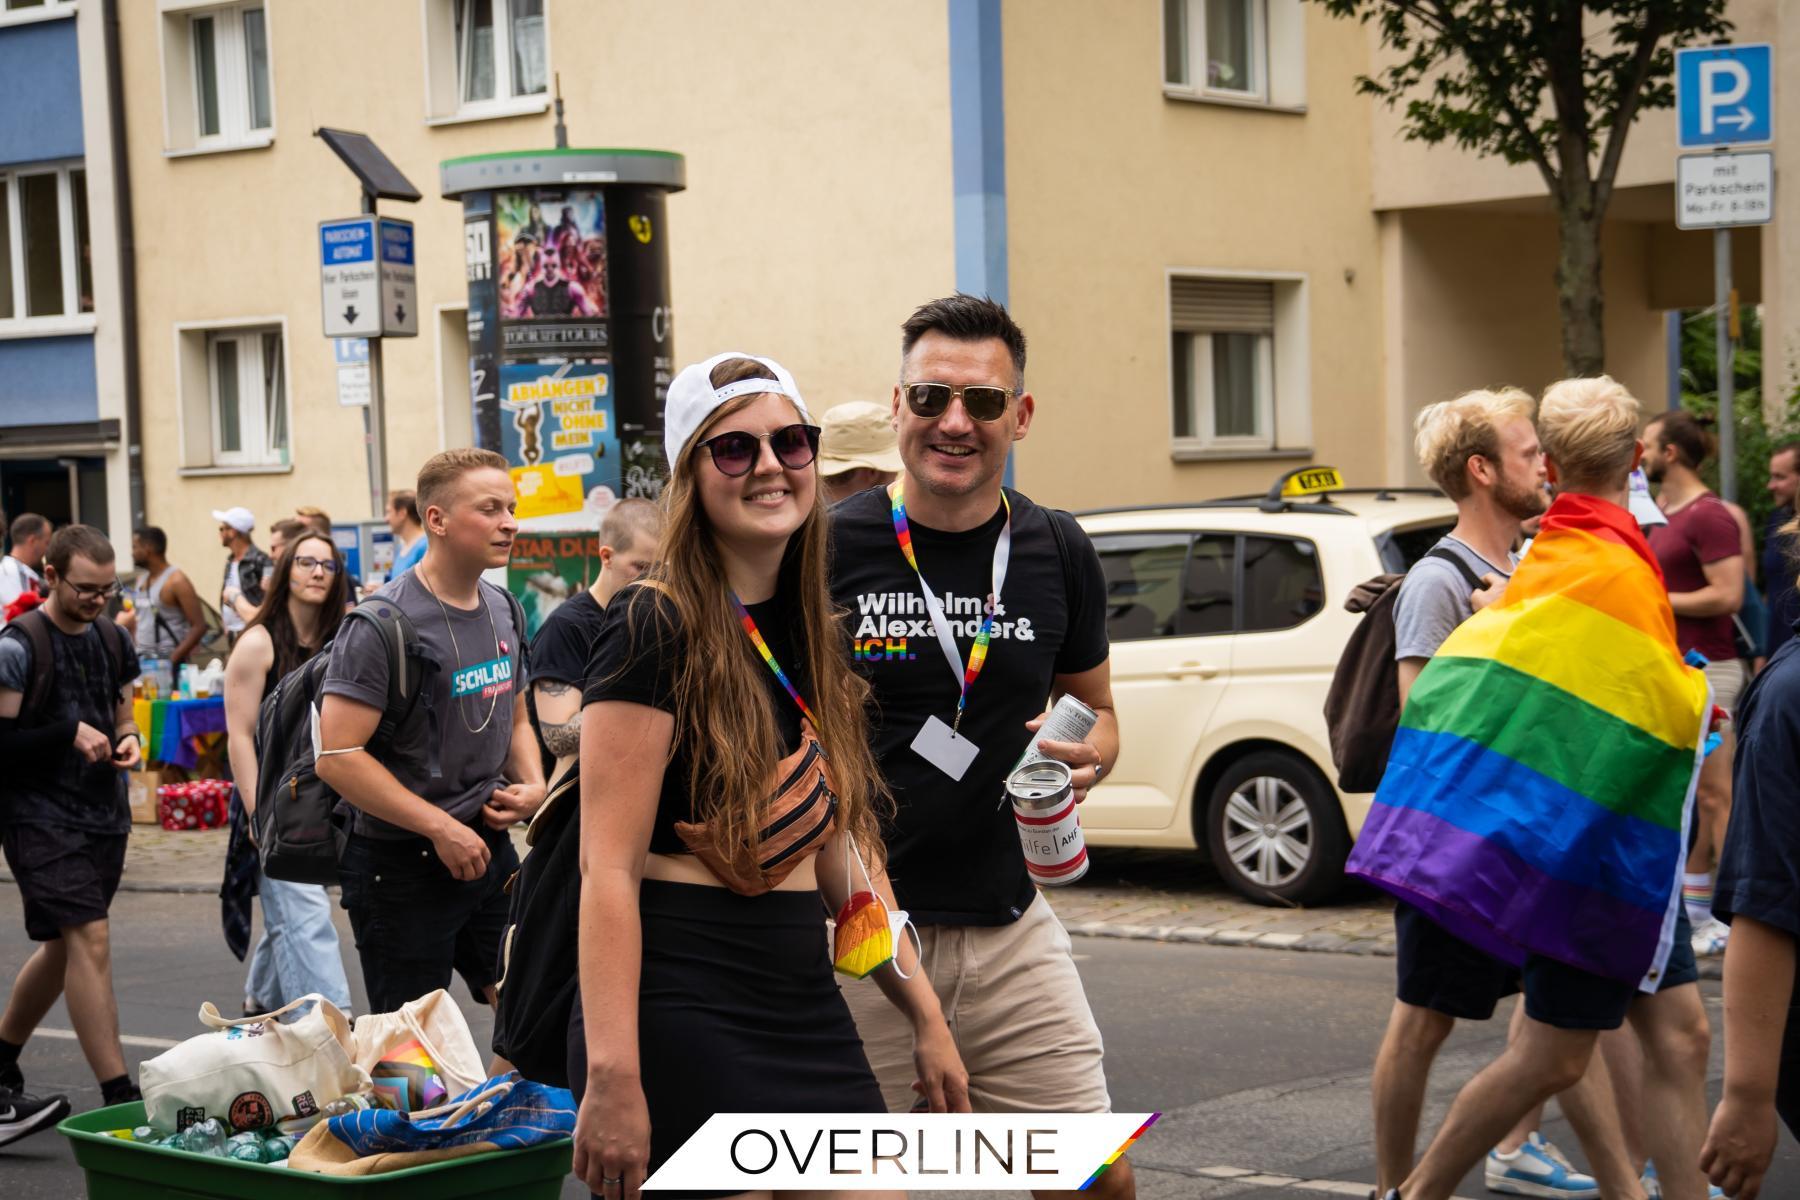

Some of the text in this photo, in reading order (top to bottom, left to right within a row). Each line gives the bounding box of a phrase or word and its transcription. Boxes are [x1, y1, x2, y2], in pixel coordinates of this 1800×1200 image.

[1699, 60, 1750, 135] P
[1713, 165, 1738, 177] mit
[1685, 181, 1766, 197] Parkschein
[511, 375, 607, 402] ABHÄNGEN?
[553, 400, 592, 413] NICHT
[562, 413, 605, 430] OHNE
[555, 433, 590, 446] MEIN
[1298, 471, 1337, 489] TAXI
[511, 536, 600, 559] STAR DUS
[854, 637, 917, 662] ICH.
[456, 660, 511, 693] SCHLAU
[1061, 827, 1078, 847] AHF
